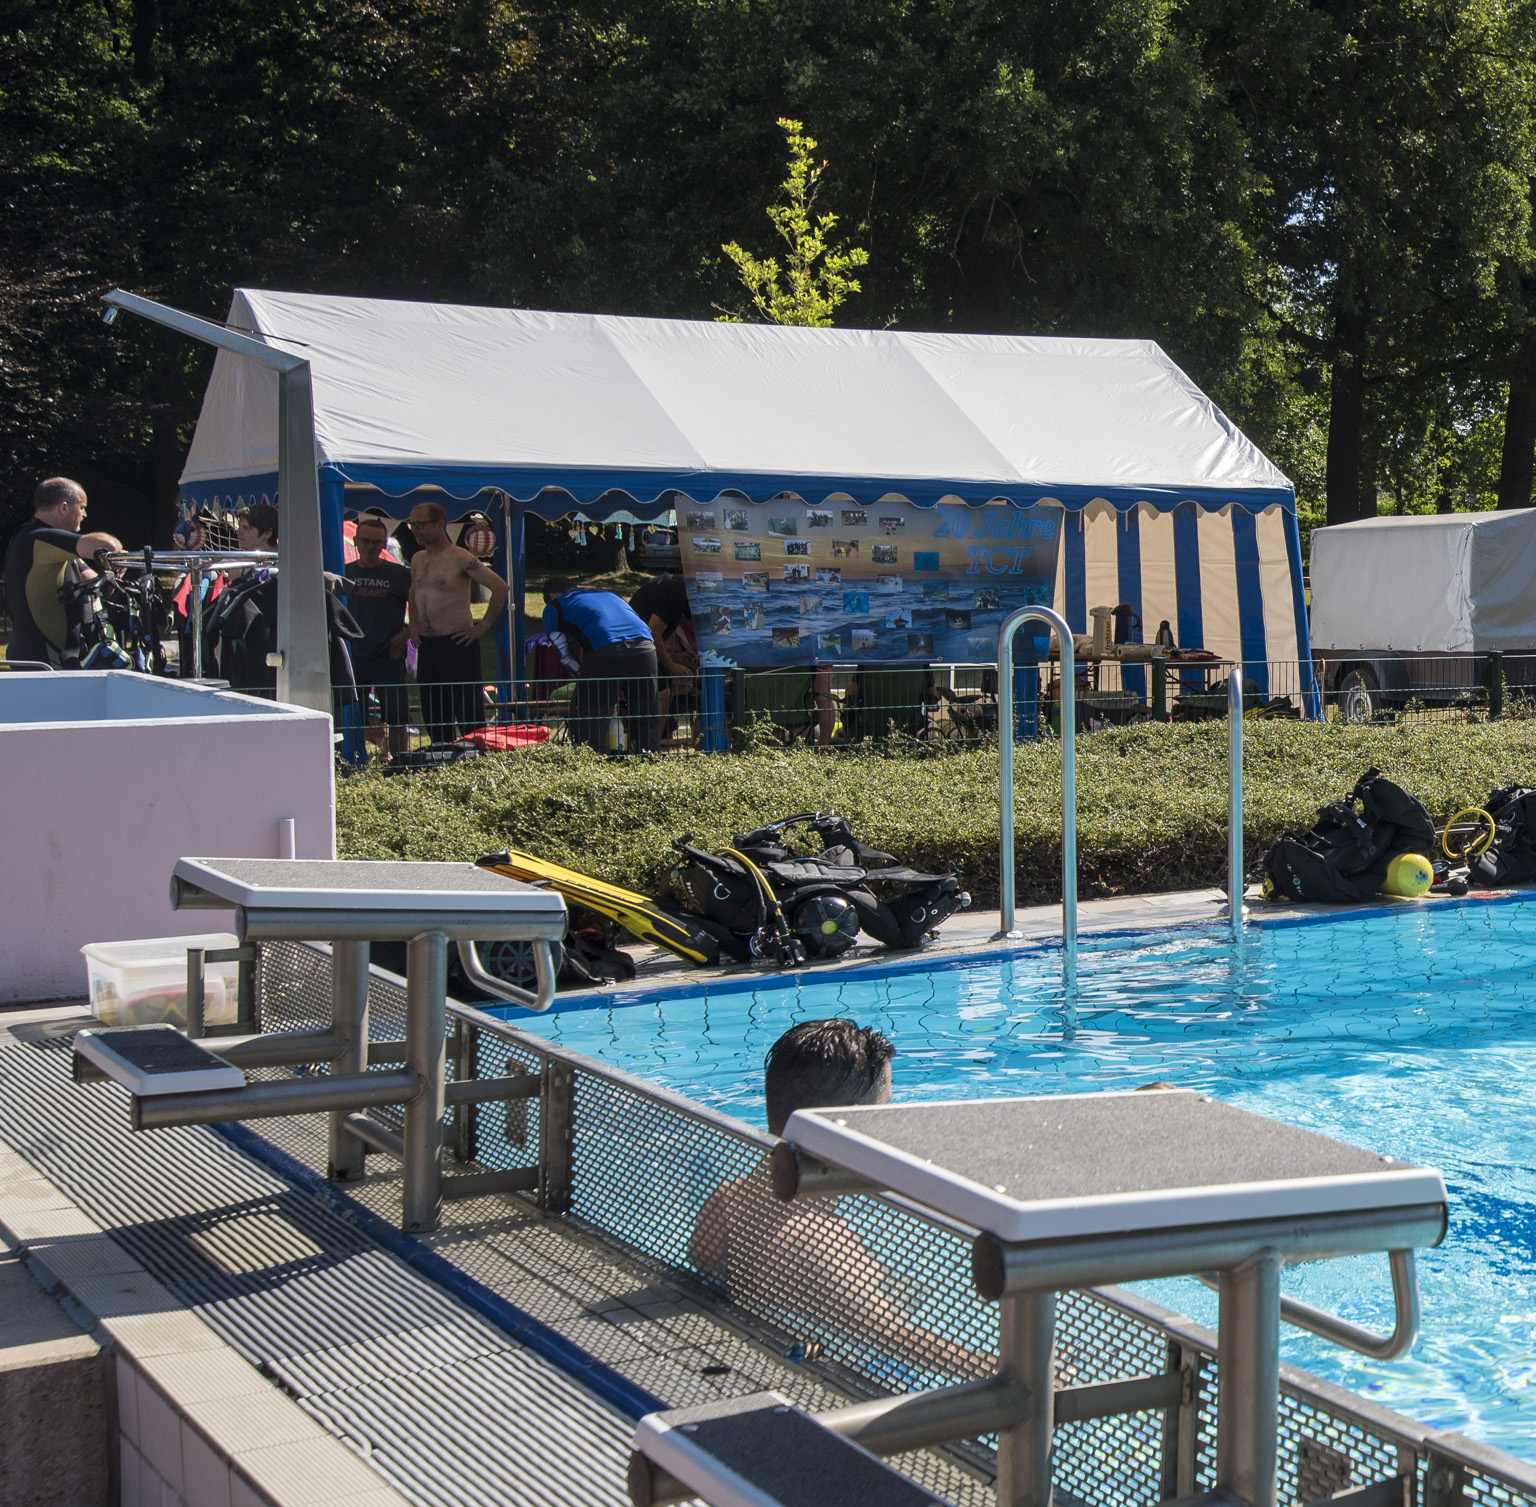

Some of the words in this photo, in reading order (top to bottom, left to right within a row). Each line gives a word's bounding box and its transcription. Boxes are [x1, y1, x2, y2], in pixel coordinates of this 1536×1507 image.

[932, 509, 970, 539] 20
[973, 509, 1056, 540] Jahre
[965, 545, 1033, 575] TCT
